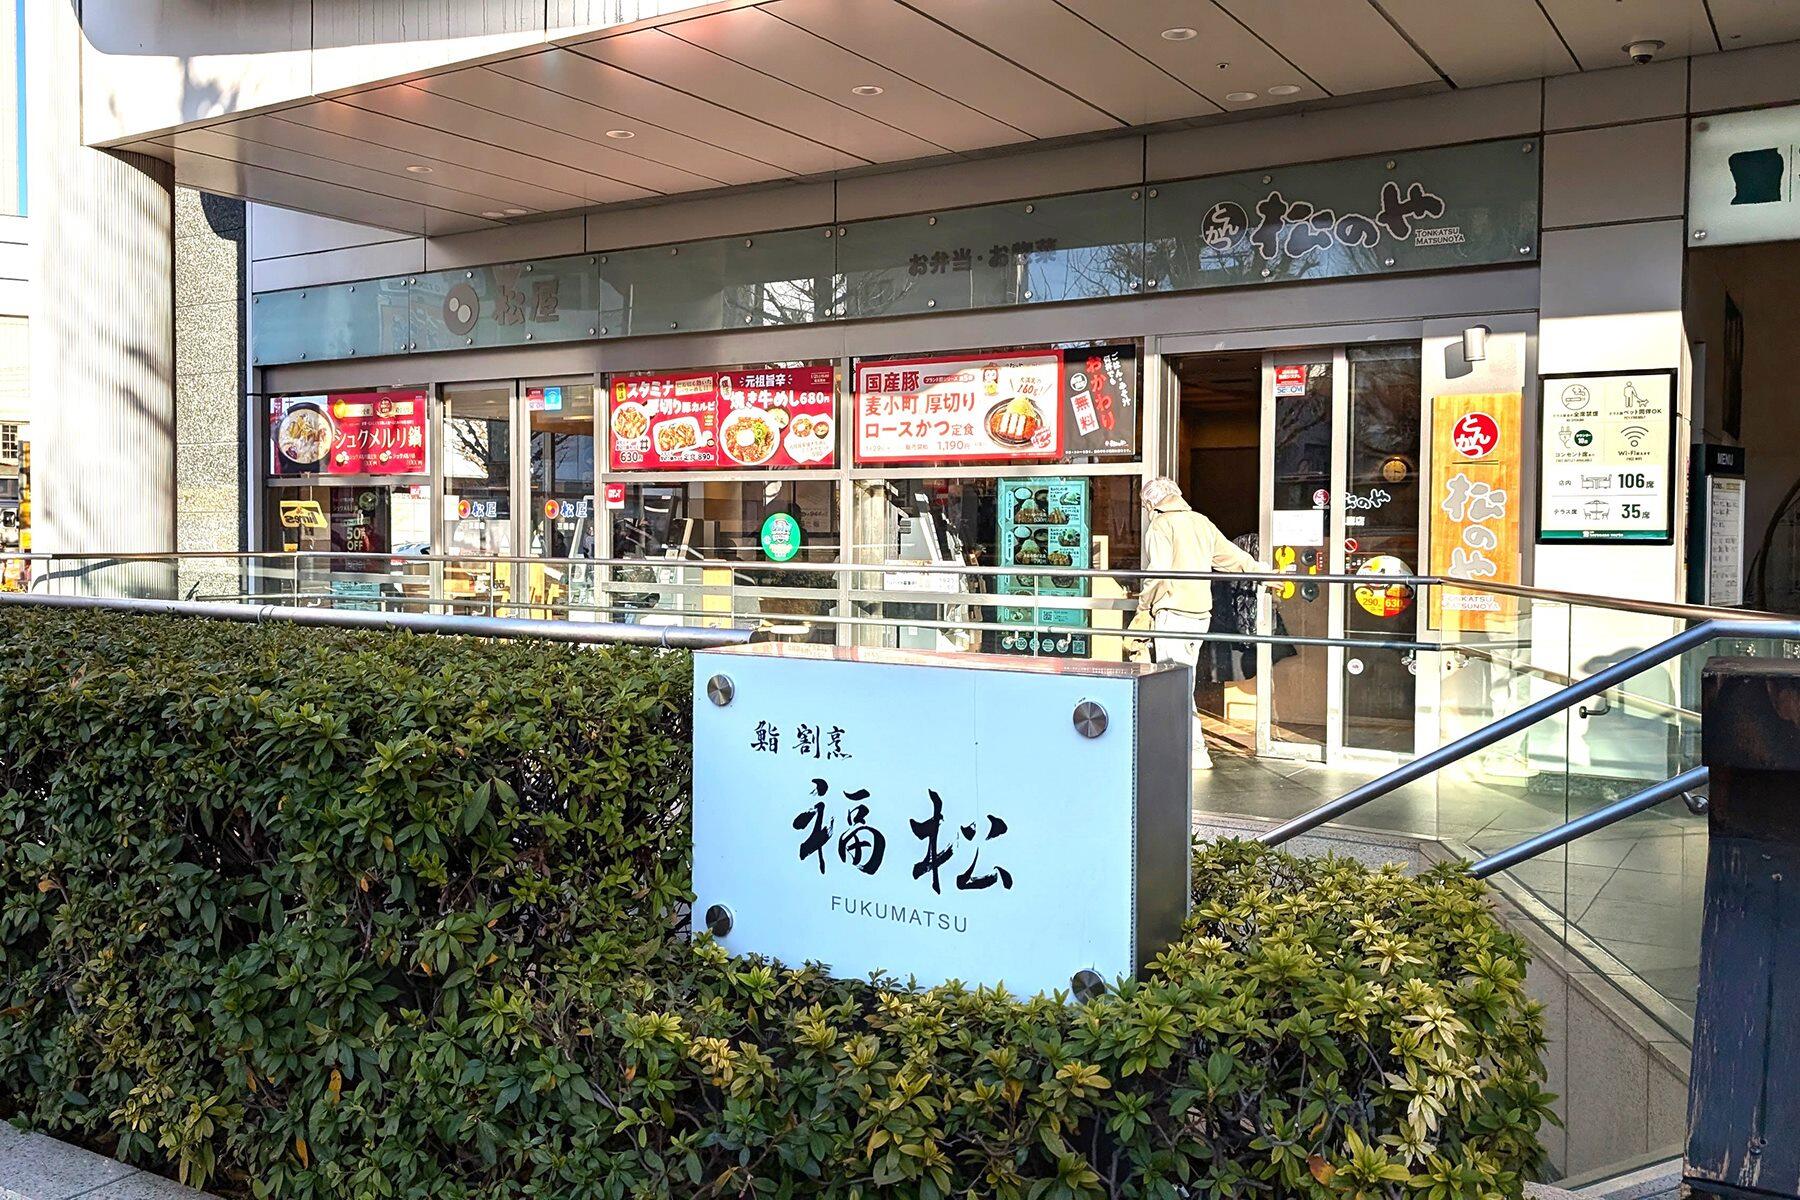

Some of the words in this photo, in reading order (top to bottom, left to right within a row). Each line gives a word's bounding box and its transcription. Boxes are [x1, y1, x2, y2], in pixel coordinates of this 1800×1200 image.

[1202, 202, 1248, 250] とんかつ
[1250, 181, 1445, 260] 松のや
[1415, 227, 1460, 237] TONKATSU
[1415, 236, 1466, 246] MATSUNOYA
[627, 381, 674, 400] スタミナ
[864, 371, 919, 395] 国産豚
[864, 395, 920, 419] 麦小町
[924, 391, 976, 415] 厚切り
[1074, 396, 1097, 431] 無料
[334, 426, 423, 450] シュクメルリ鍋
[864, 418, 951, 440] ロースかつ
[951, 422, 976, 438] 定食
[1455, 413, 1493, 458] とんかつ
[472, 501, 497, 518] 松屋
[560, 500, 588, 518] 松屋
[1441, 473, 1507, 580] 松のや
[346, 540, 364, 551] OFF
[750, 719, 780, 755] 鮨
[791, 724, 853, 761] 割烹
[830, 896, 968, 933] FUKUMATSU
